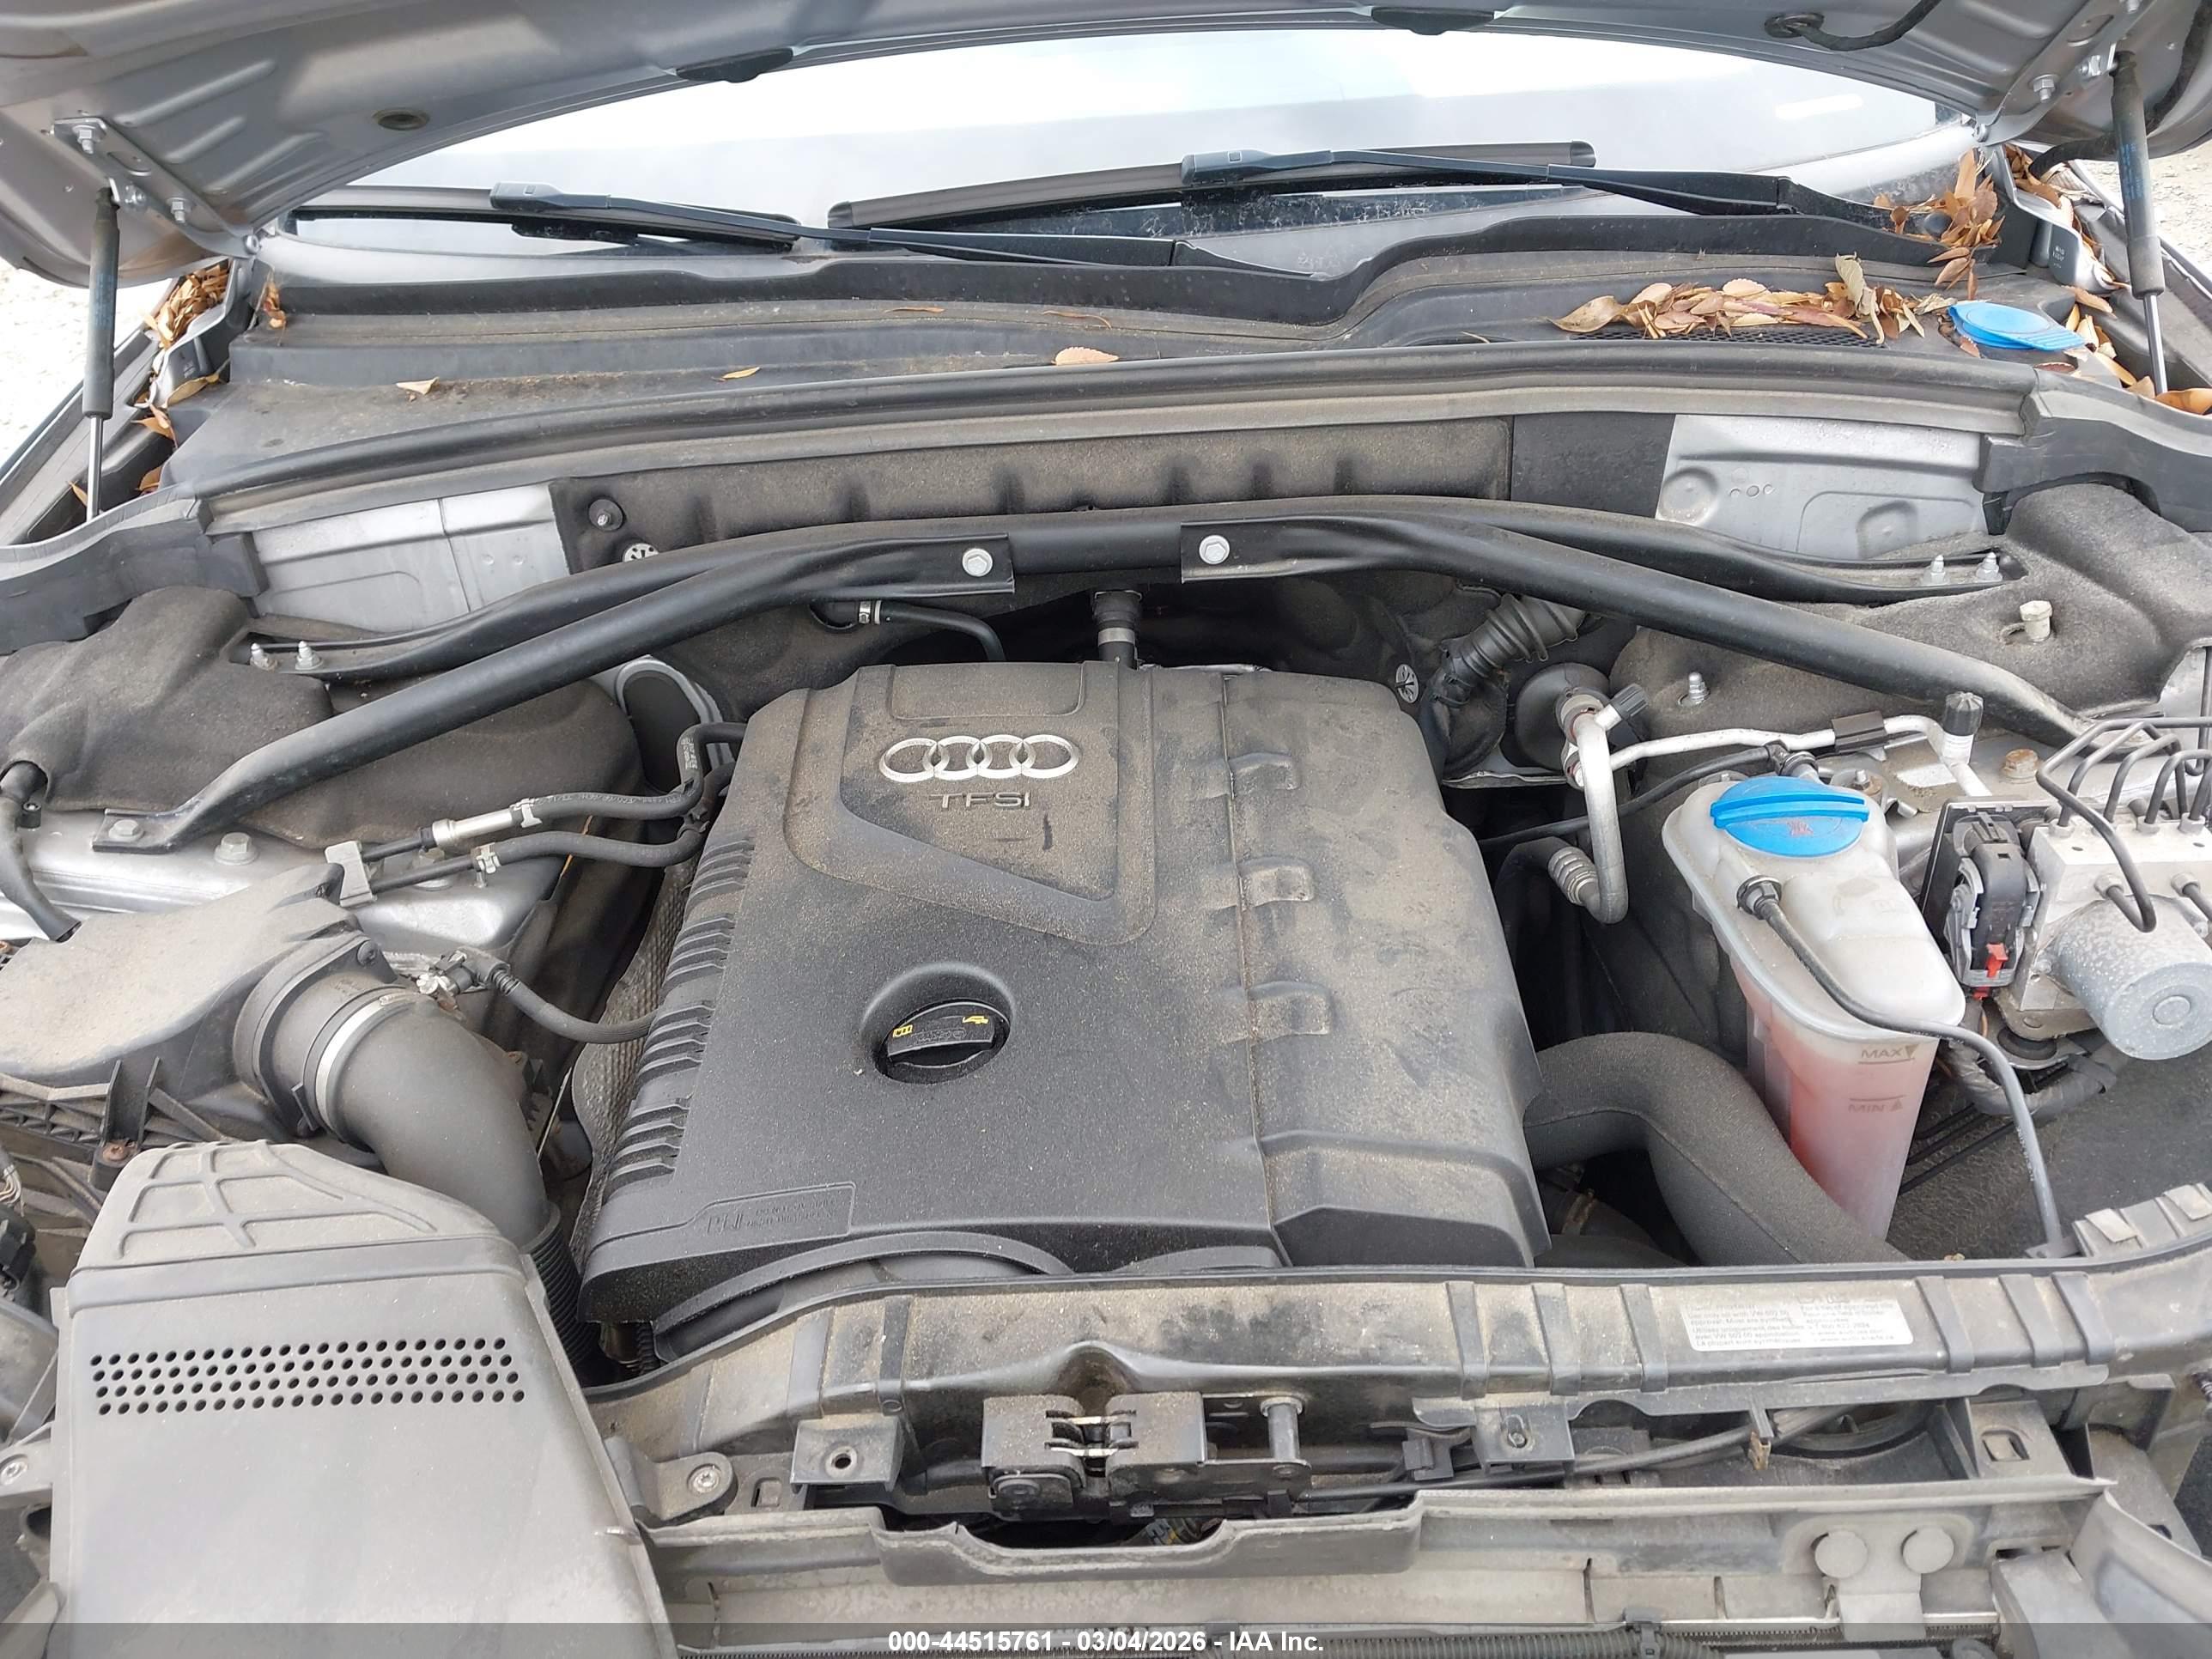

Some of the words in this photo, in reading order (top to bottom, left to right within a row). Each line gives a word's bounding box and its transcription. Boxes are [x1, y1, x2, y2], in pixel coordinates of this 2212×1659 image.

[929, 791, 1030, 810] TFSI
[1861, 1048, 1903, 1058] MAX
[1848, 1103, 1886, 1113] MIN
